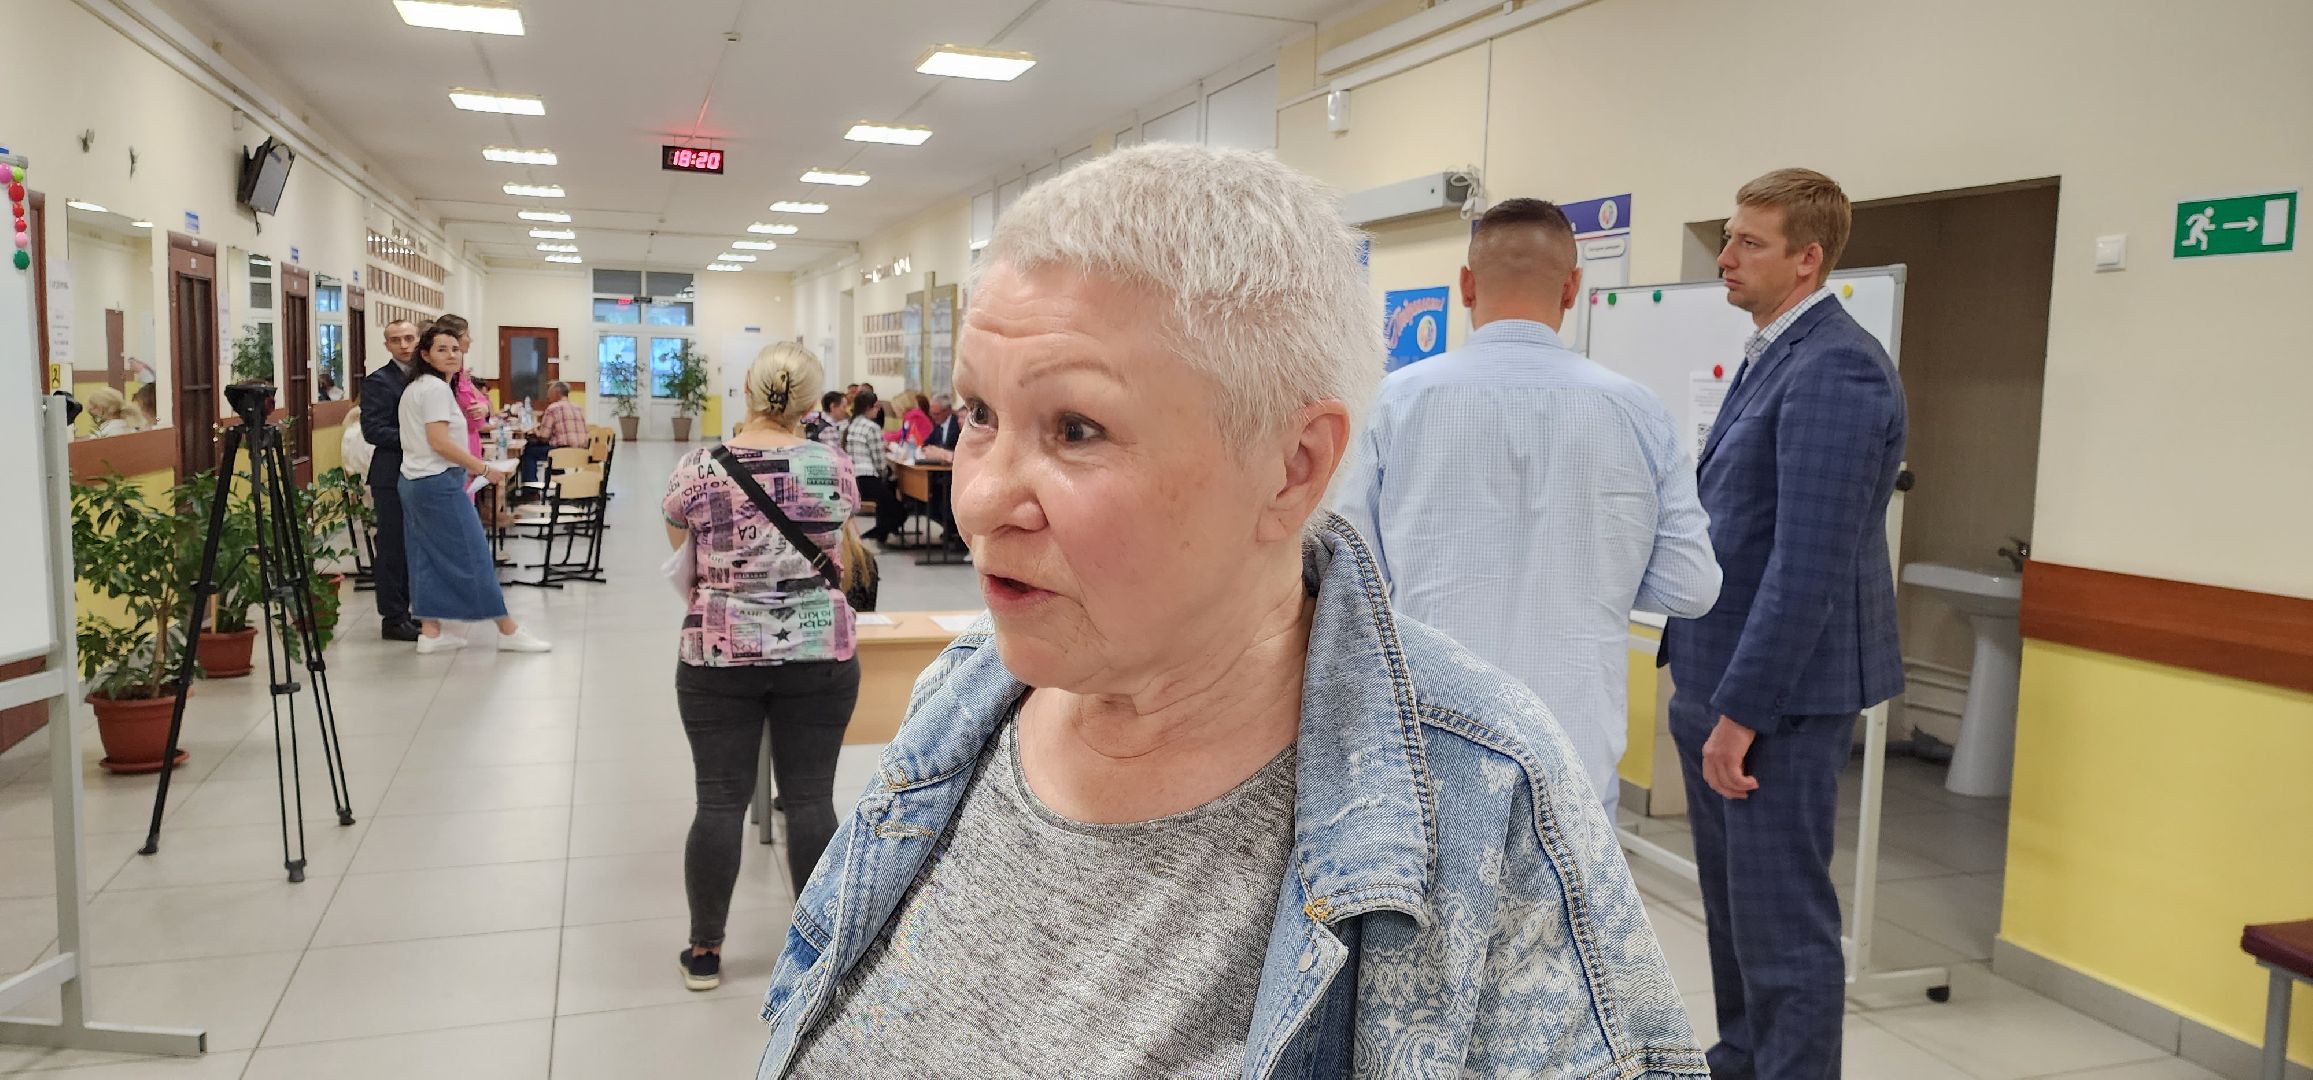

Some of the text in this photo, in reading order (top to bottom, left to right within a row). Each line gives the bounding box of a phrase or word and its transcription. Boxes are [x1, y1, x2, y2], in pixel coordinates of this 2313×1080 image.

[673, 149, 721, 170] 18:20
[697, 463, 716, 479] CA
[738, 525, 757, 541] CA
